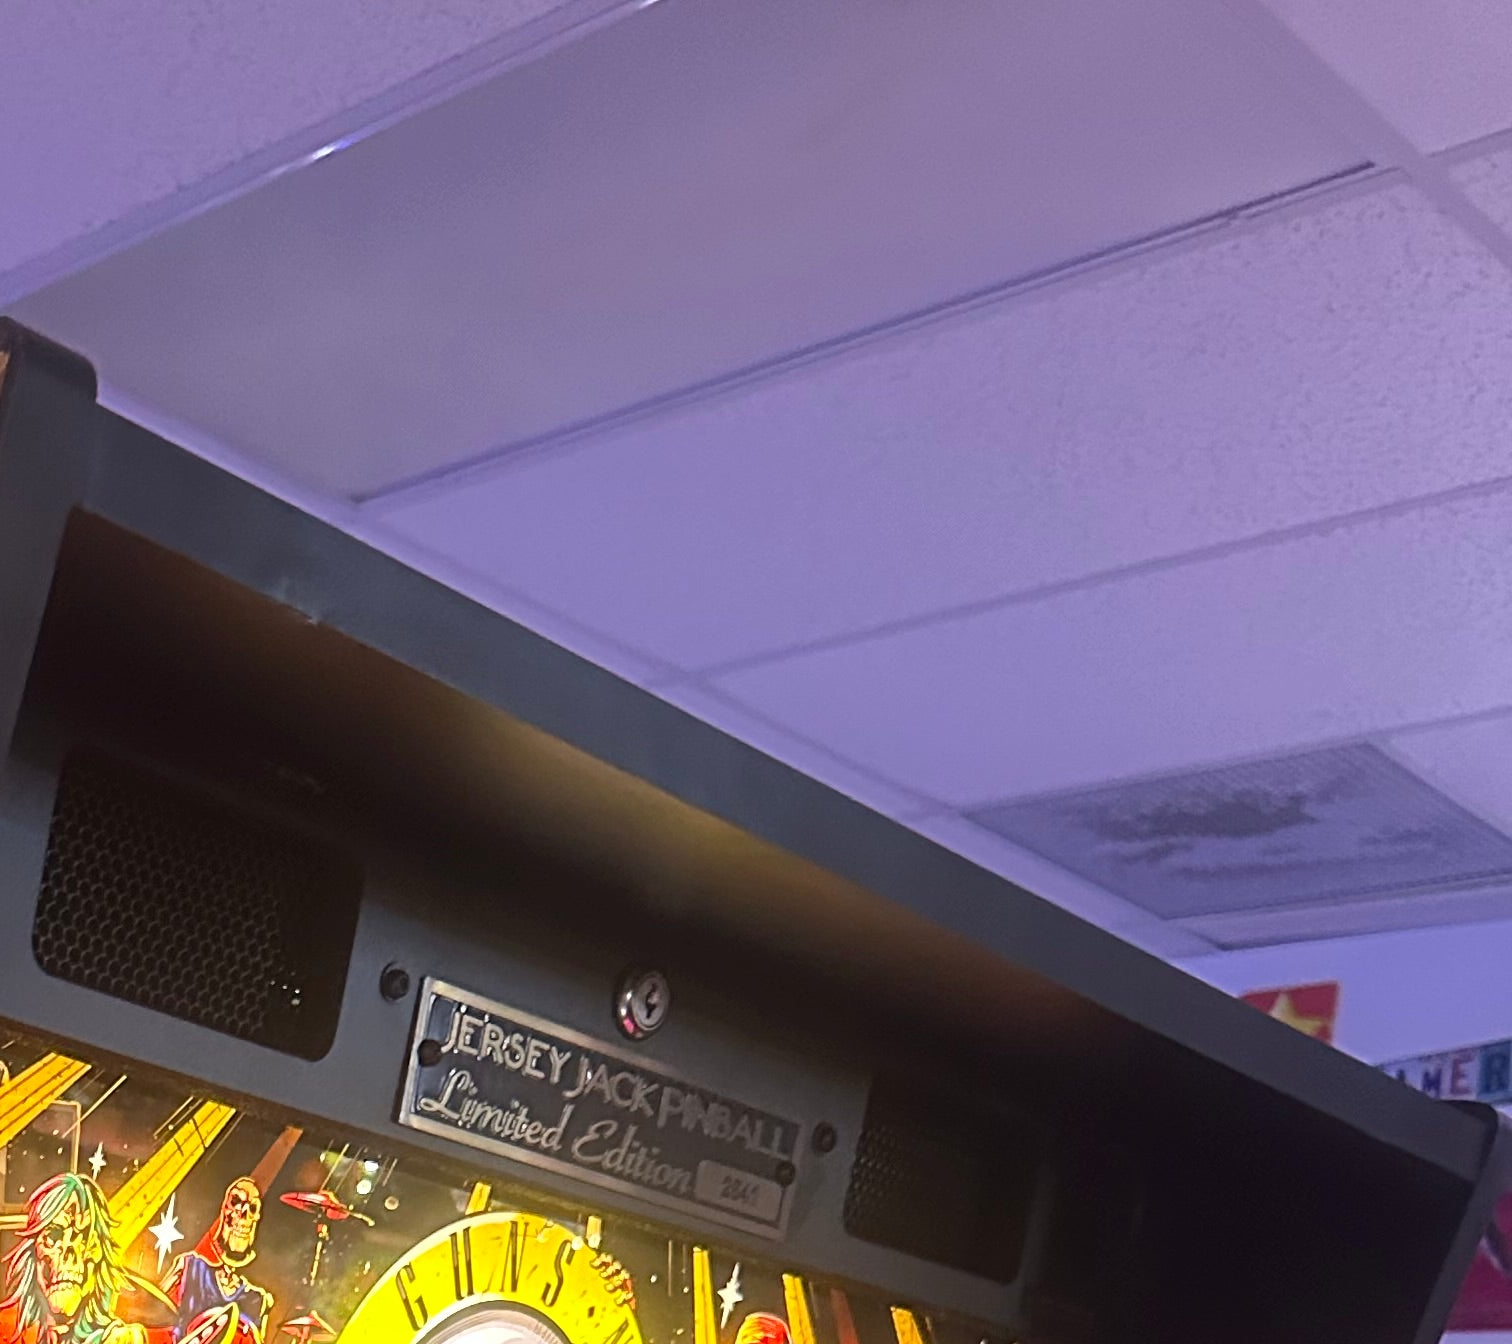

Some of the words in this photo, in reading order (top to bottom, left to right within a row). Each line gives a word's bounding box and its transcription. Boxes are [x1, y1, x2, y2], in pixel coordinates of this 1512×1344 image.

[419, 1067, 572, 1153] Limited
[573, 1121, 694, 1194] Edition
[441, 999, 572, 1086] JERSEY
[564, 1057, 657, 1117] JACK
[657, 1086, 789, 1161] PINBALL
[394, 1219, 576, 1333] GUNS
